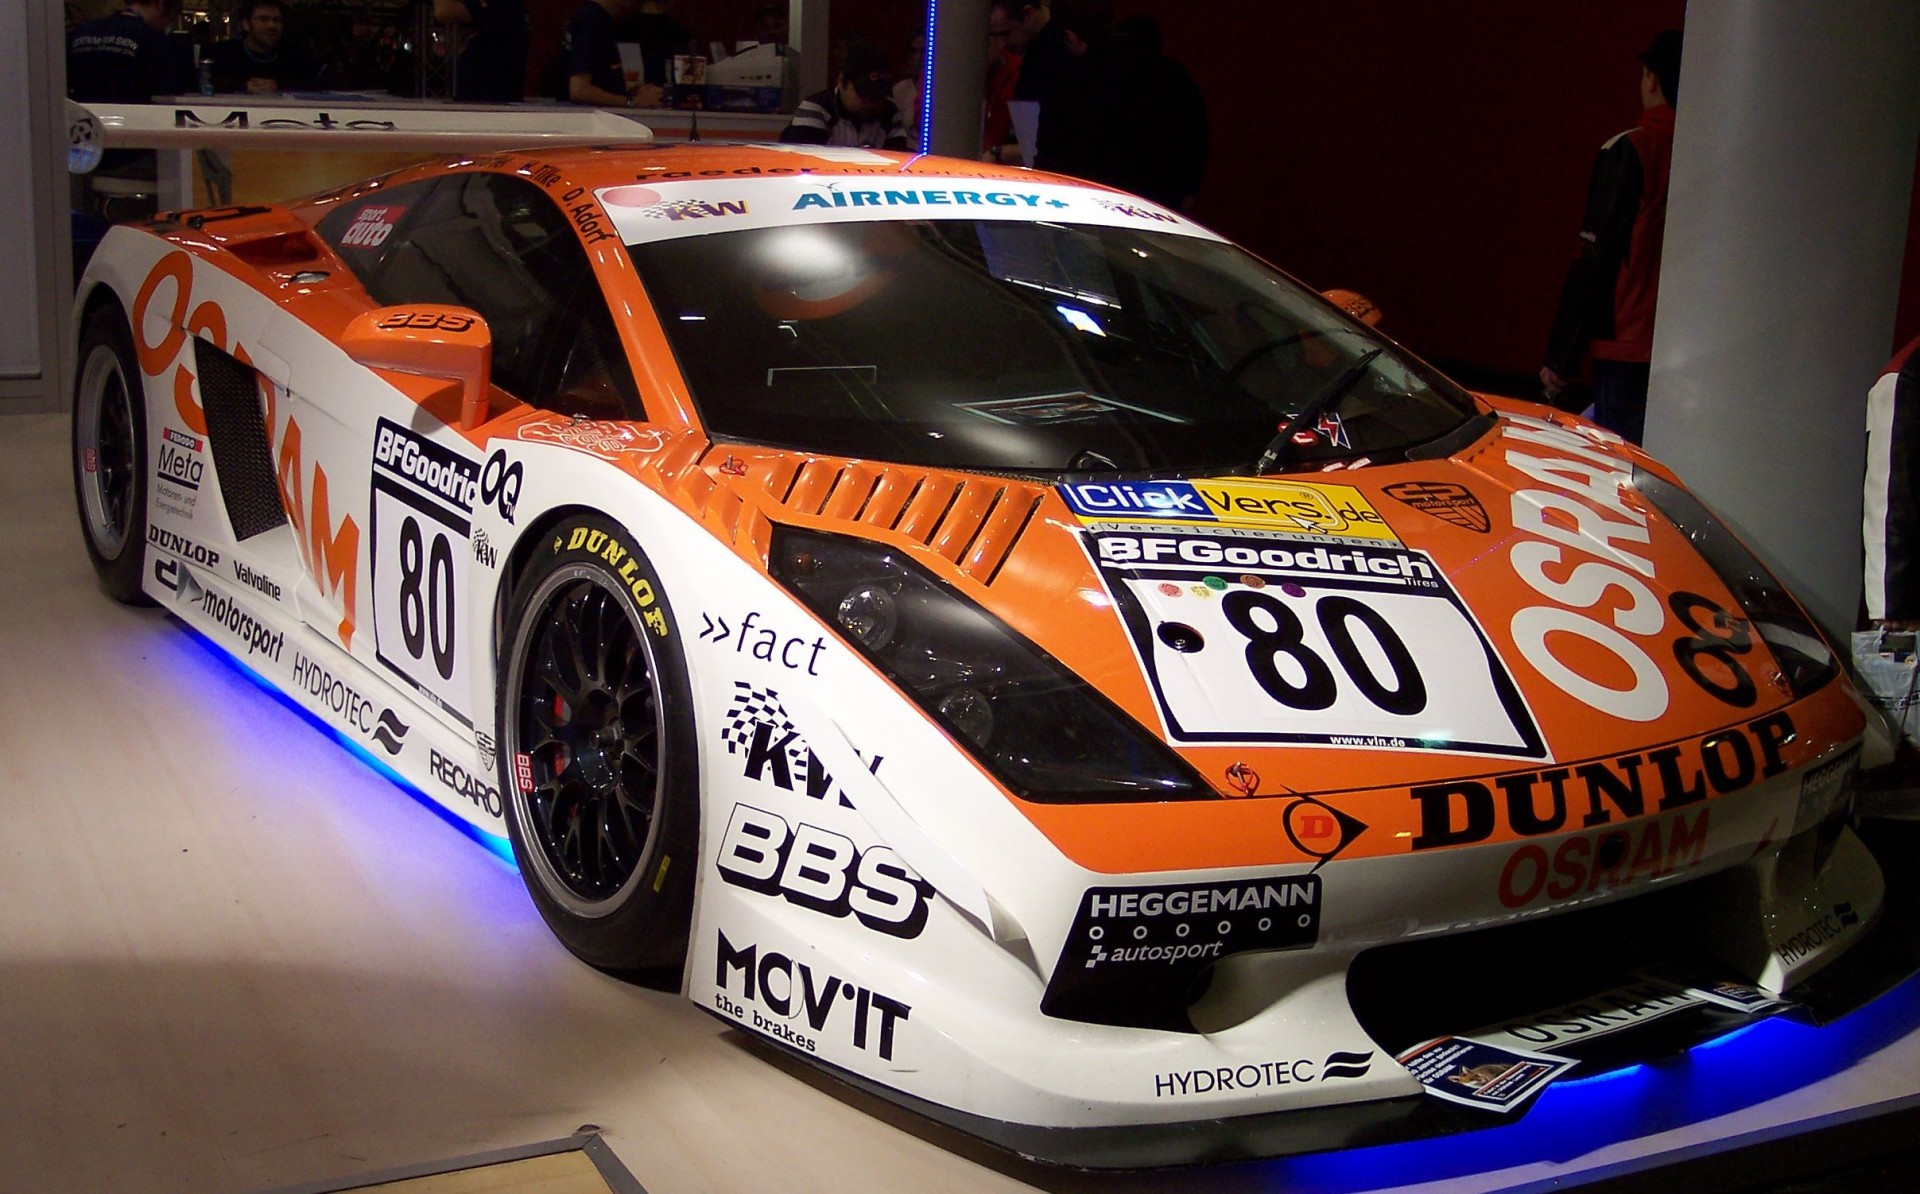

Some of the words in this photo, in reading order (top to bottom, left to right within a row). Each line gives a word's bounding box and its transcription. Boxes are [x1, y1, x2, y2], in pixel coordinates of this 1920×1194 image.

[358, 208, 388, 221] sport
[570, 203, 615, 245] Adorf
[664, 200, 749, 221] KW
[342, 219, 394, 247] auto
[378, 312, 476, 332] BBS
[170, 432, 196, 449] FERODO
[158, 445, 204, 483] Meta
[1411, 498, 1478, 509] motorsport
[149, 523, 220, 568] DUNLOP
[475, 538, 499, 570] KW
[1099, 537, 1434, 579] BFGoodrich
[233, 560, 282, 601] Valvoline
[567, 527, 668, 638] DUNLOP
[1404, 577, 1439, 589] Tires
[1494, 410, 1671, 723] OSRAM
[399, 515, 456, 681] 80
[202, 588, 284, 663] motorsport
[1221, 590, 1428, 717] 80
[294, 651, 374, 736] HYDROTEC
[1329, 735, 1406, 748] www.vln.de
[430, 748, 502, 818] RECARO
[516, 753, 533, 790] BBS
[1411, 711, 1796, 851] DUNLOP
[716, 801, 937, 941] BBS
[1499, 808, 1711, 910] OSRAM
[1090, 882, 1315, 918] HEGGEMANN
[1110, 940, 1224, 963] autosport
[1776, 916, 1841, 966] HYDROTEC
[715, 992, 746, 1019] the
[752, 1009, 818, 1053] brakes
[1156, 1060, 1315, 1097] HYDROTEC
